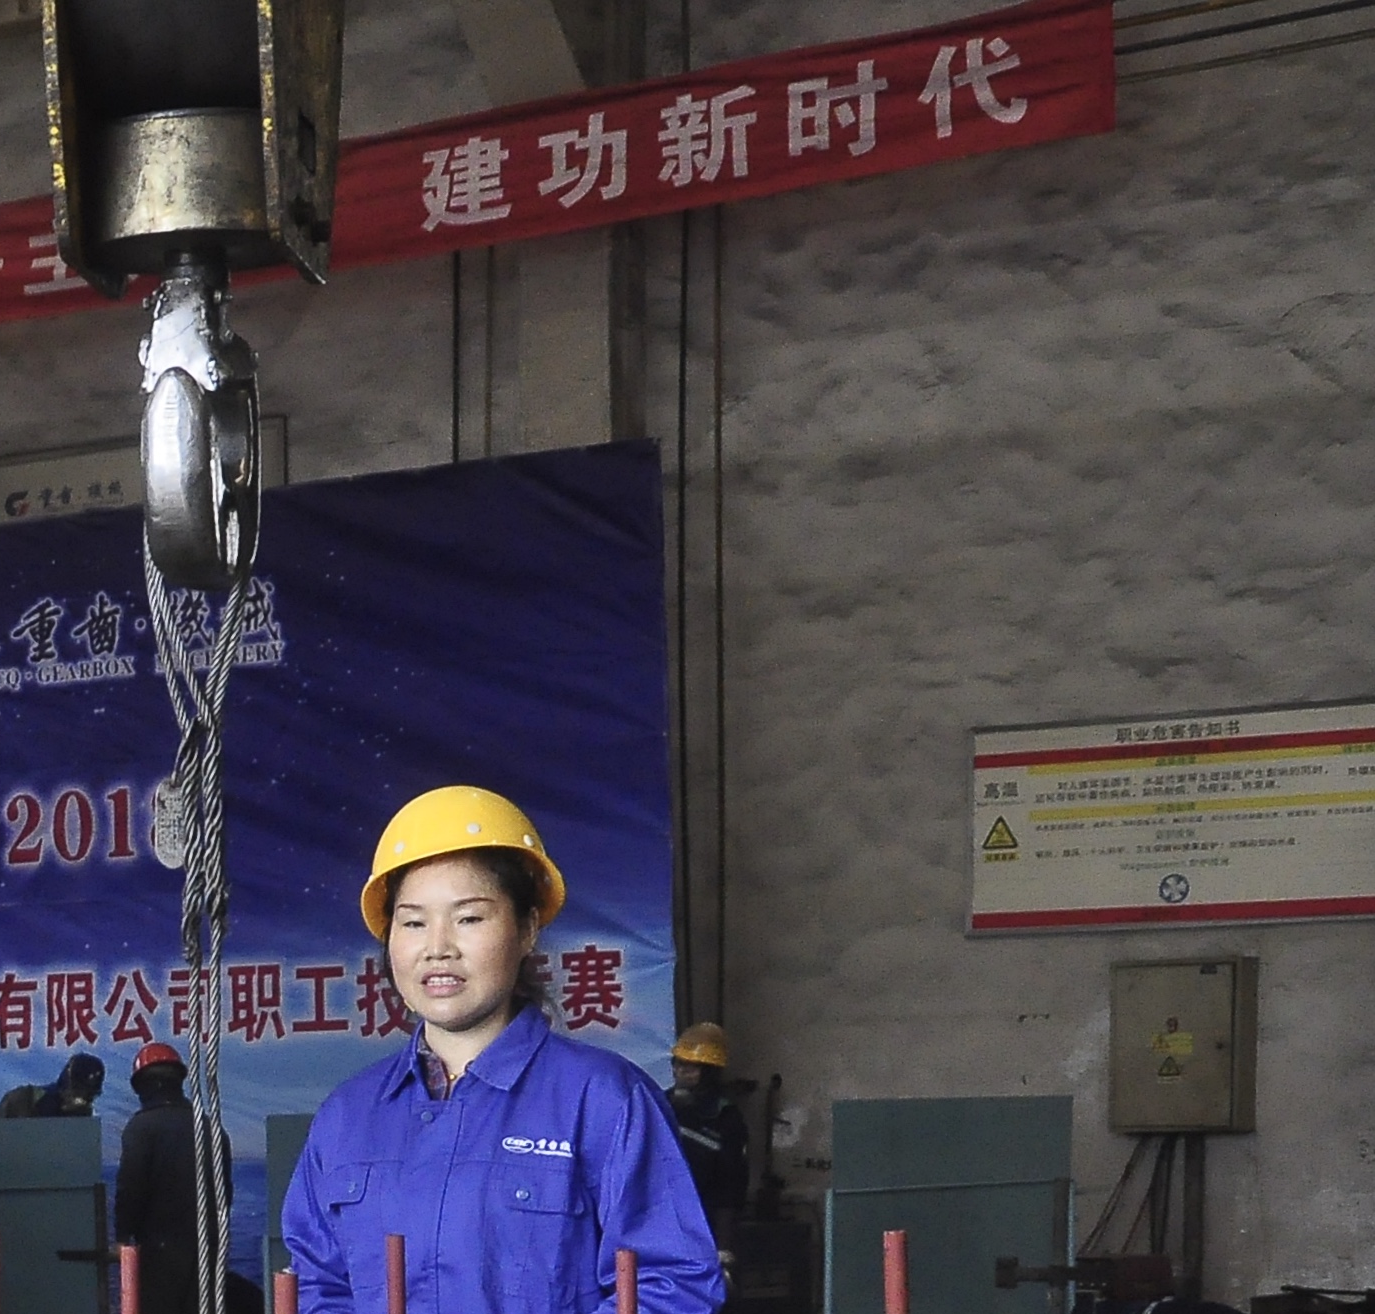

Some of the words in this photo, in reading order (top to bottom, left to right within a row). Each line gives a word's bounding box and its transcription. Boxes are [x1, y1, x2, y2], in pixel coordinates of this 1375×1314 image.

[422, 37, 1028, 232] 建功新时代
[7, 788, 157, 864] 201
